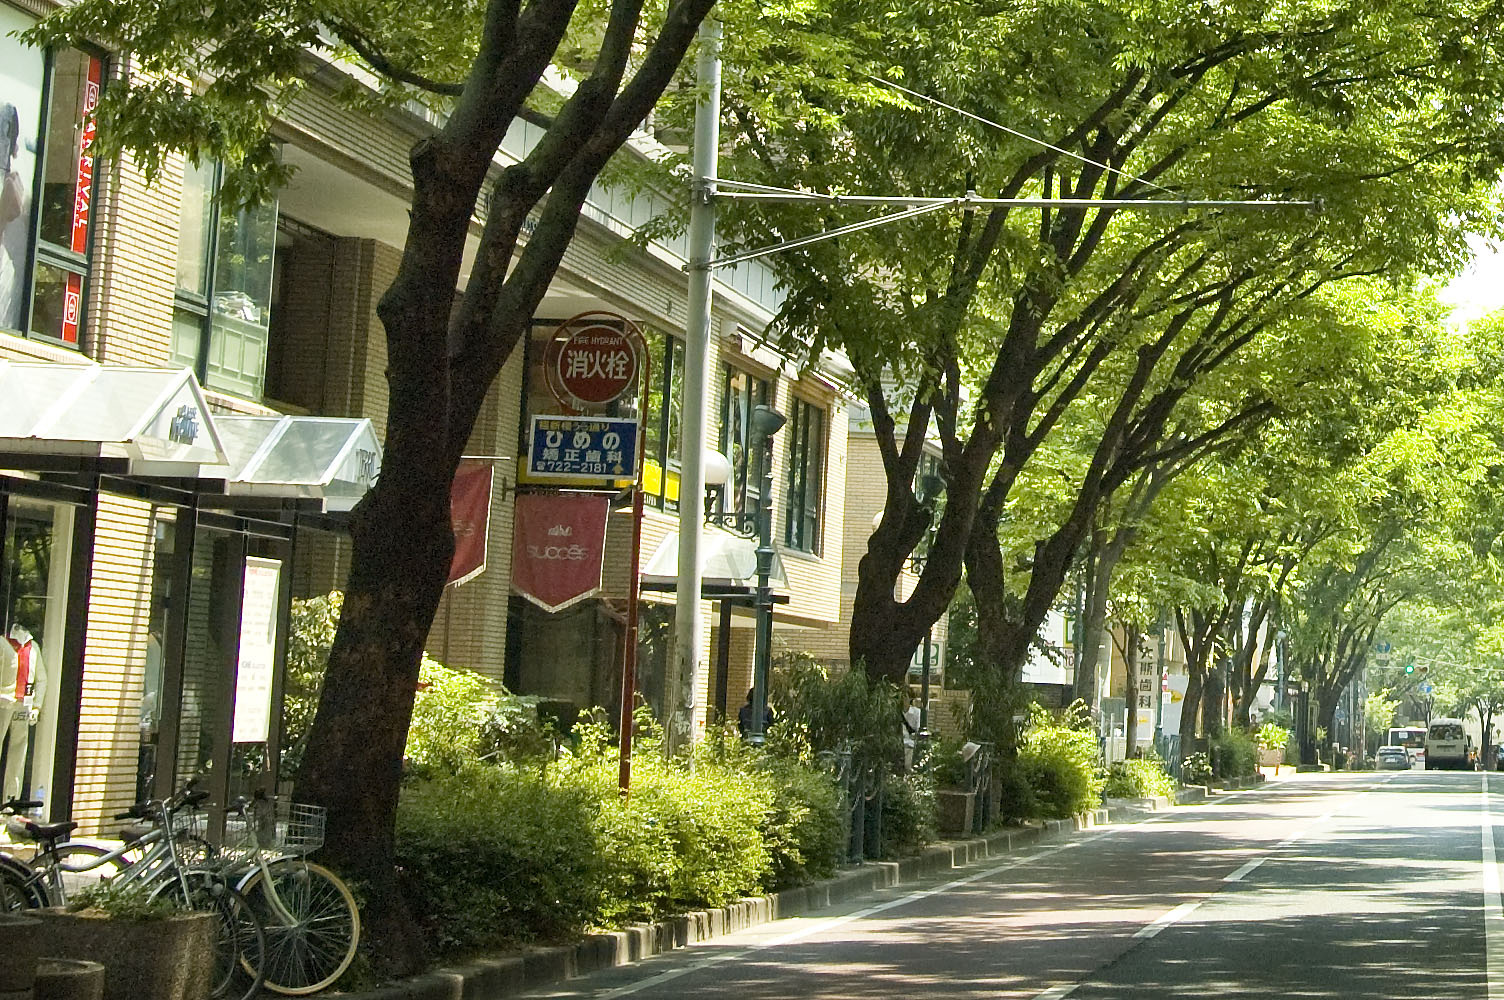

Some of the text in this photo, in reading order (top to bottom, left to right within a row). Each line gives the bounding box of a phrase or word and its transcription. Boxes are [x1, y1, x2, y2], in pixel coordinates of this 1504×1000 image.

[566, 350, 630, 379] 消火栓
[545, 430, 620, 450] ひめの
[542, 448, 623, 464] 矯正歯科
[547, 462, 607, 473] 722-2181
